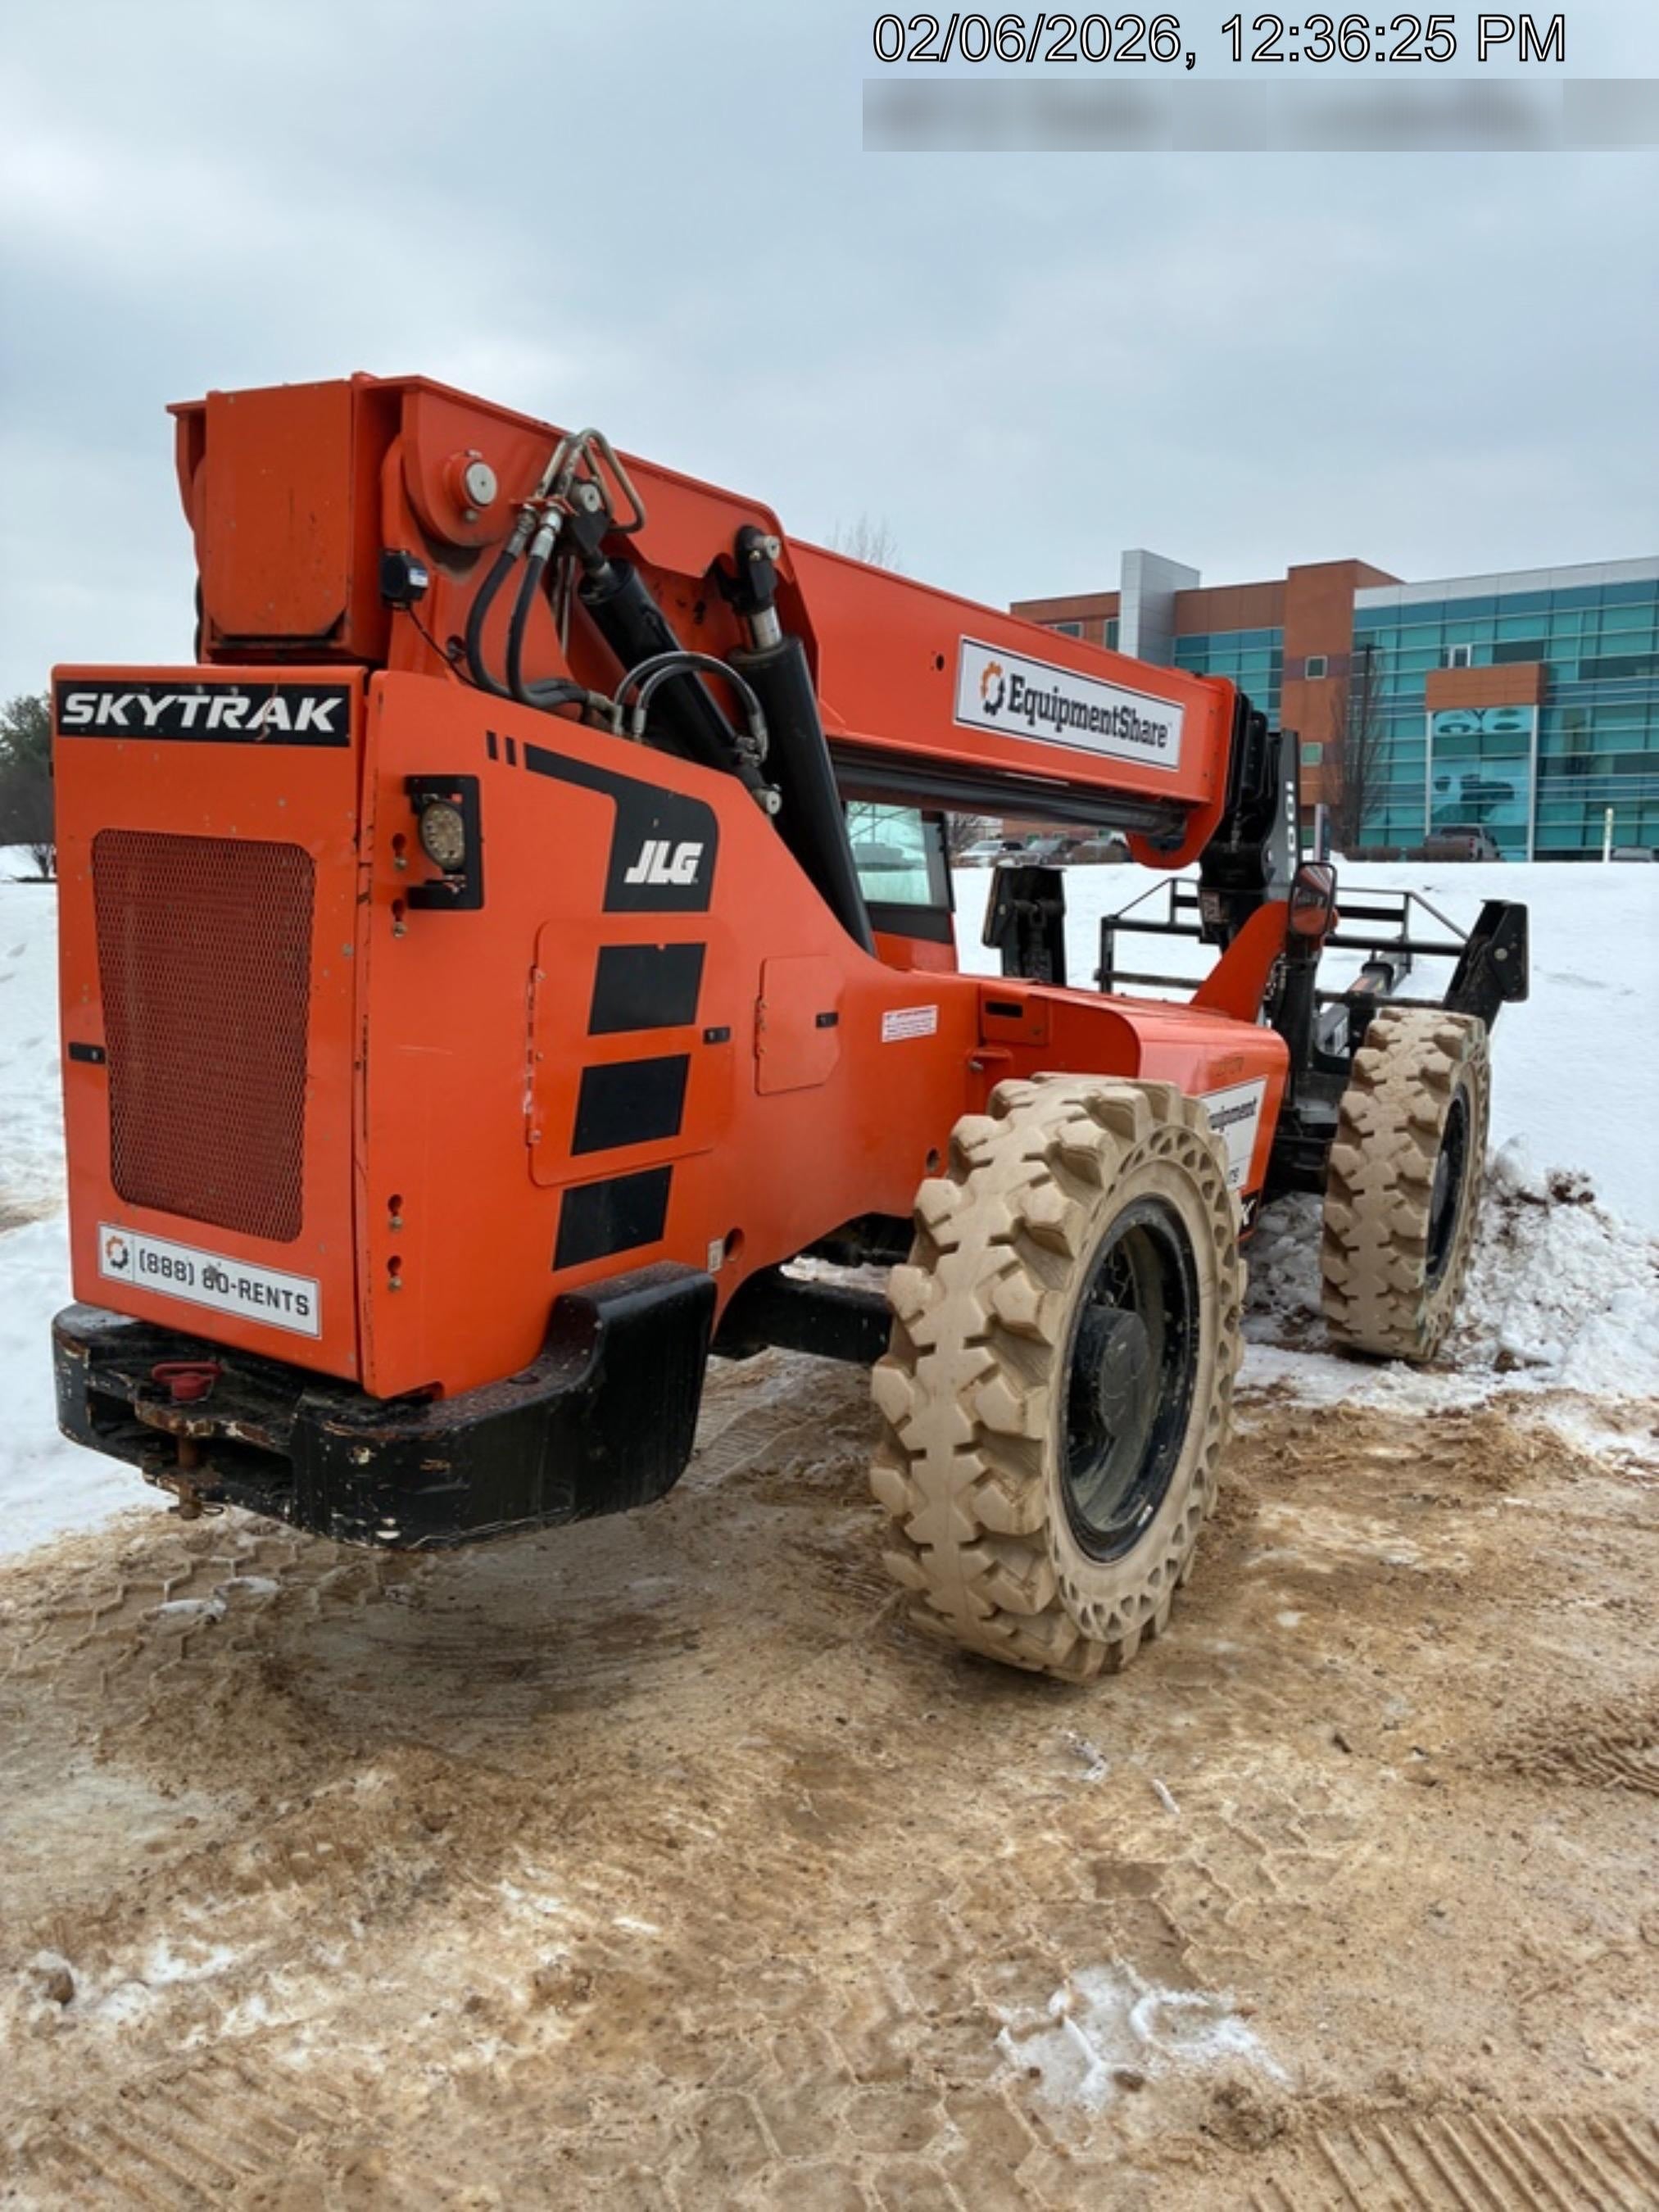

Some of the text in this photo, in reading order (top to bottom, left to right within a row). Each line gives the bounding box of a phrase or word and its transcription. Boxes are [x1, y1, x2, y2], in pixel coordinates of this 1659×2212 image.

[61, 692, 342, 732] SKYTRAK
[1007, 673, 1168, 749] EquipmentShare
[623, 840, 705, 885] JLG
[138, 1248, 310, 1317] (888) 80-RENTS
